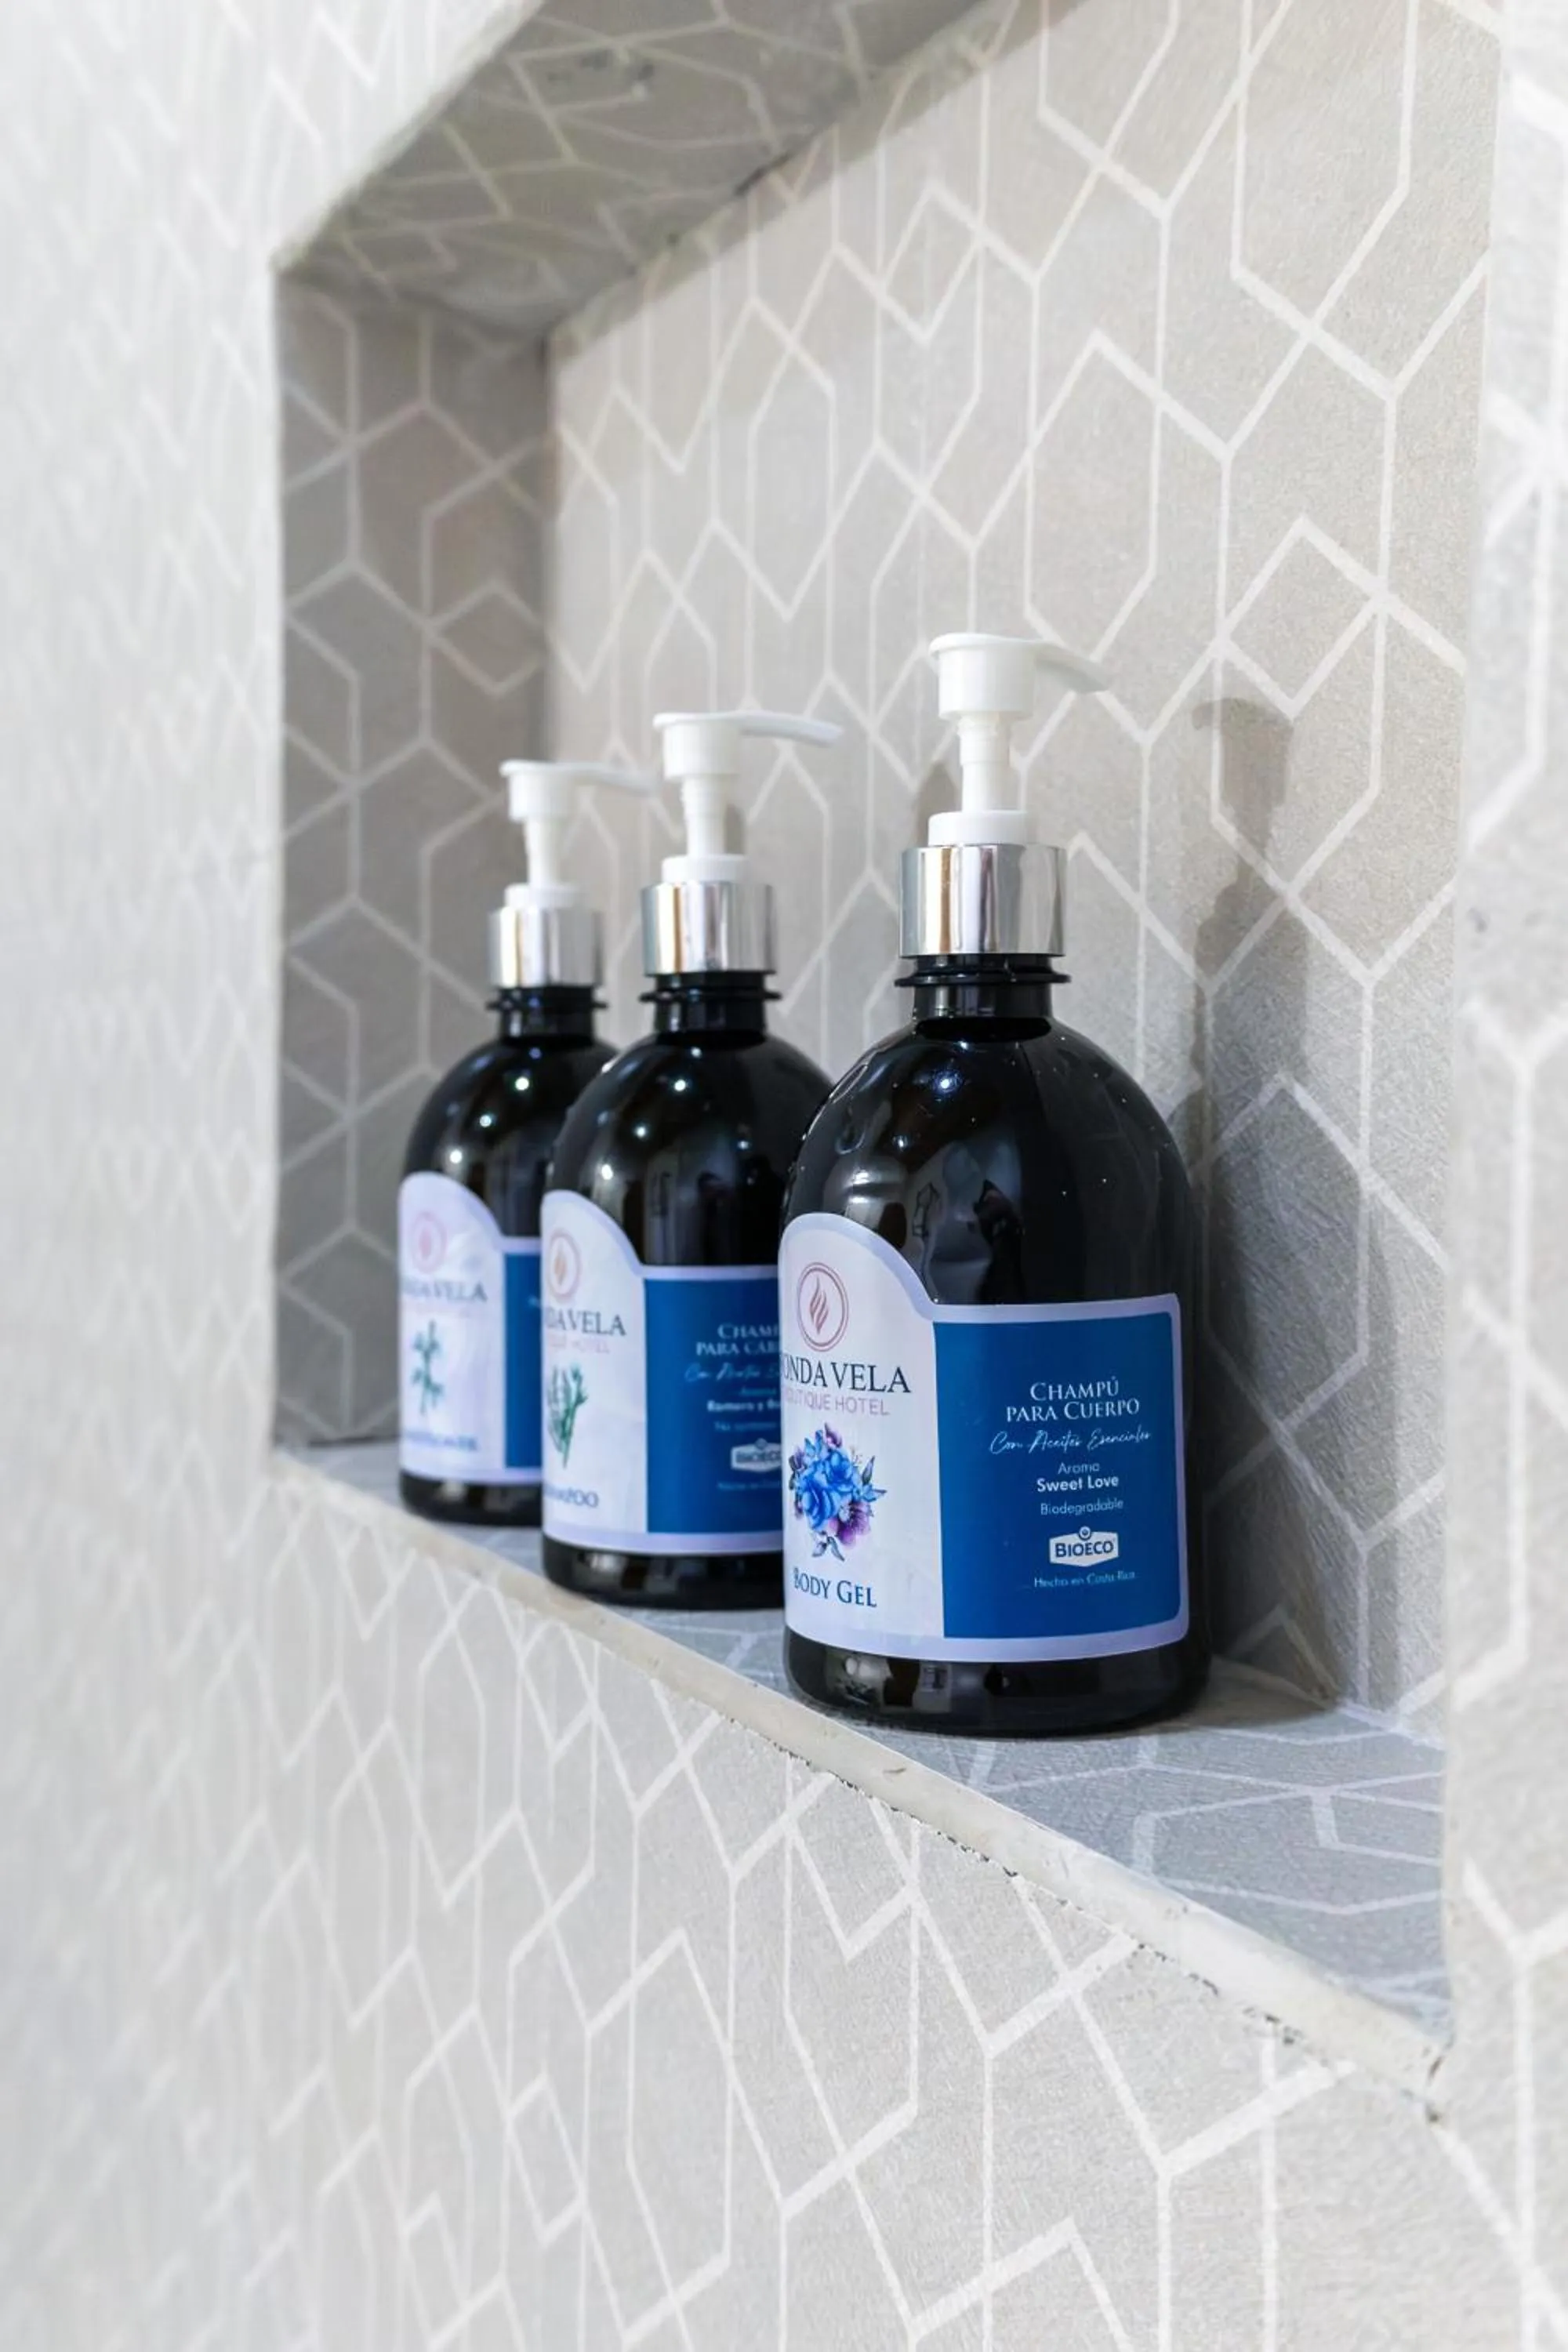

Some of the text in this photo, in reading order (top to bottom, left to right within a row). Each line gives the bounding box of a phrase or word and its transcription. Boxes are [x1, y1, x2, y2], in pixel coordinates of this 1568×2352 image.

[1029, 1375, 1120, 1402] CHAMPÚ
[834, 1395, 891, 1416] HOTEL
[1006, 1398, 1140, 1423] PARA CUERPO
[990, 1424, 1152, 1454] Con Aceites Esenciales
[1058, 1462, 1101, 1475] Aroma
[1036, 1475, 1120, 1493] Sweet Love
[1040, 1497, 1124, 1515] Biodegradable
[1054, 1541, 1114, 1558] BIOECO
